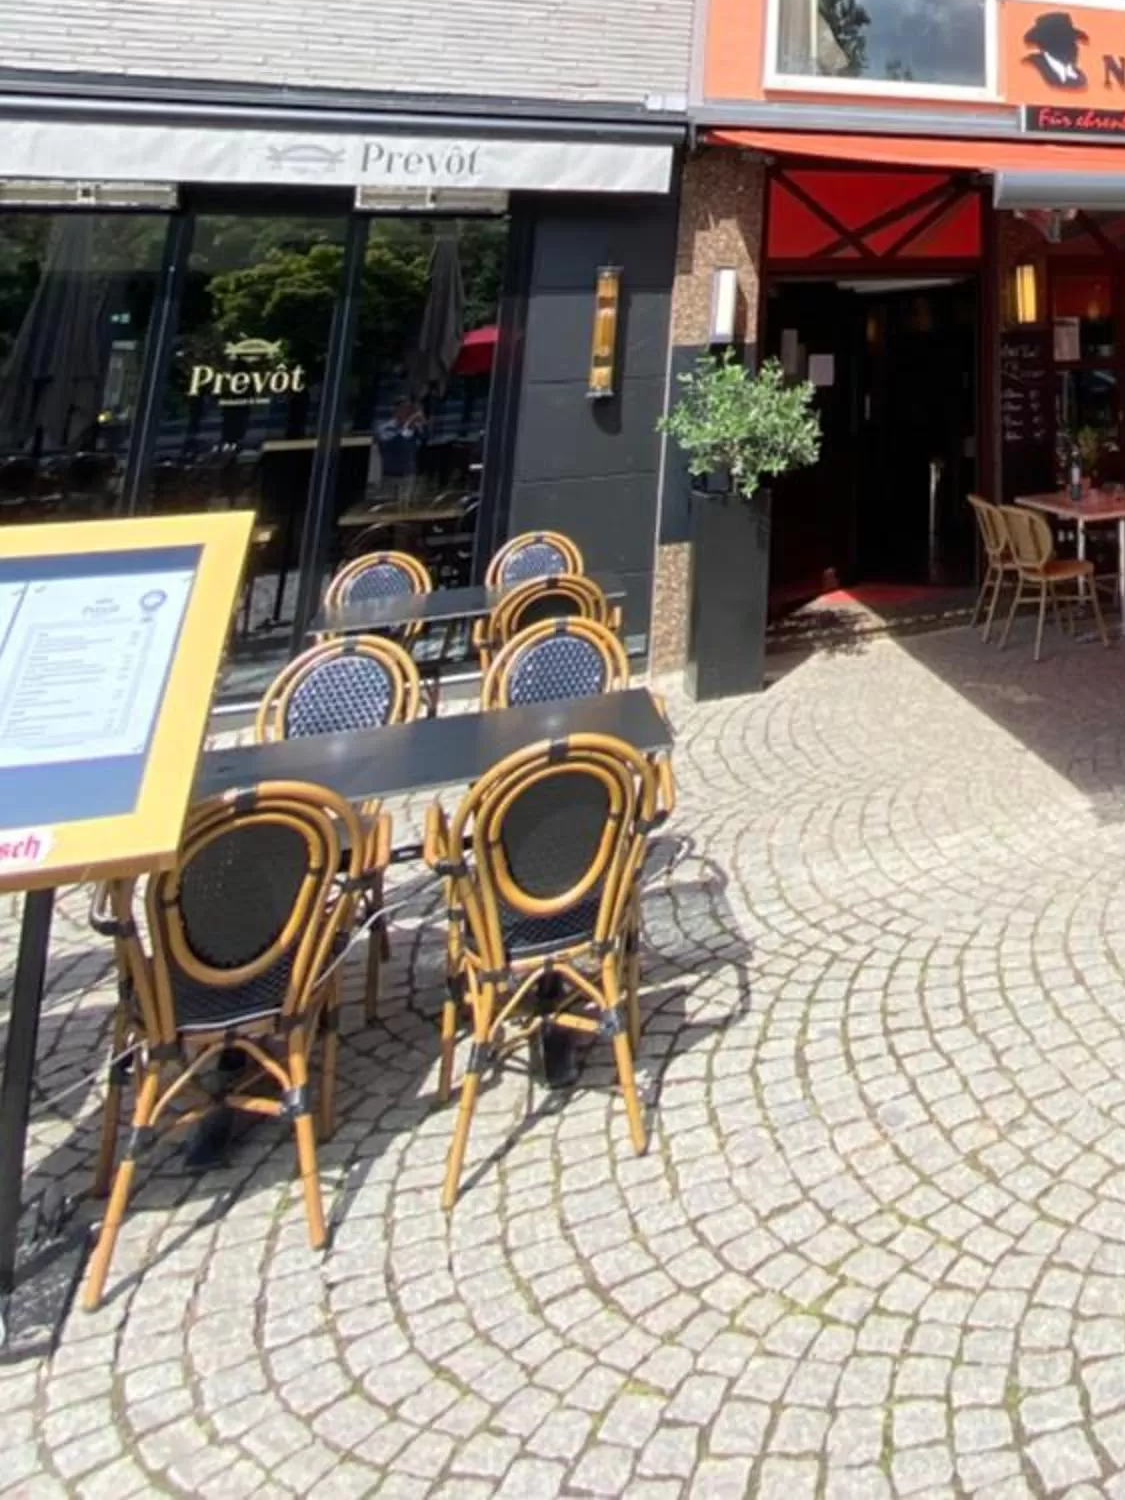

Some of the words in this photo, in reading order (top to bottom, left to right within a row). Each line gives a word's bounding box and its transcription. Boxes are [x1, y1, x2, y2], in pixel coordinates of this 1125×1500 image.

[1038, 107, 1073, 128] Für
[360, 142, 483, 177] Prevôt
[186, 363, 306, 396] Prevôt
